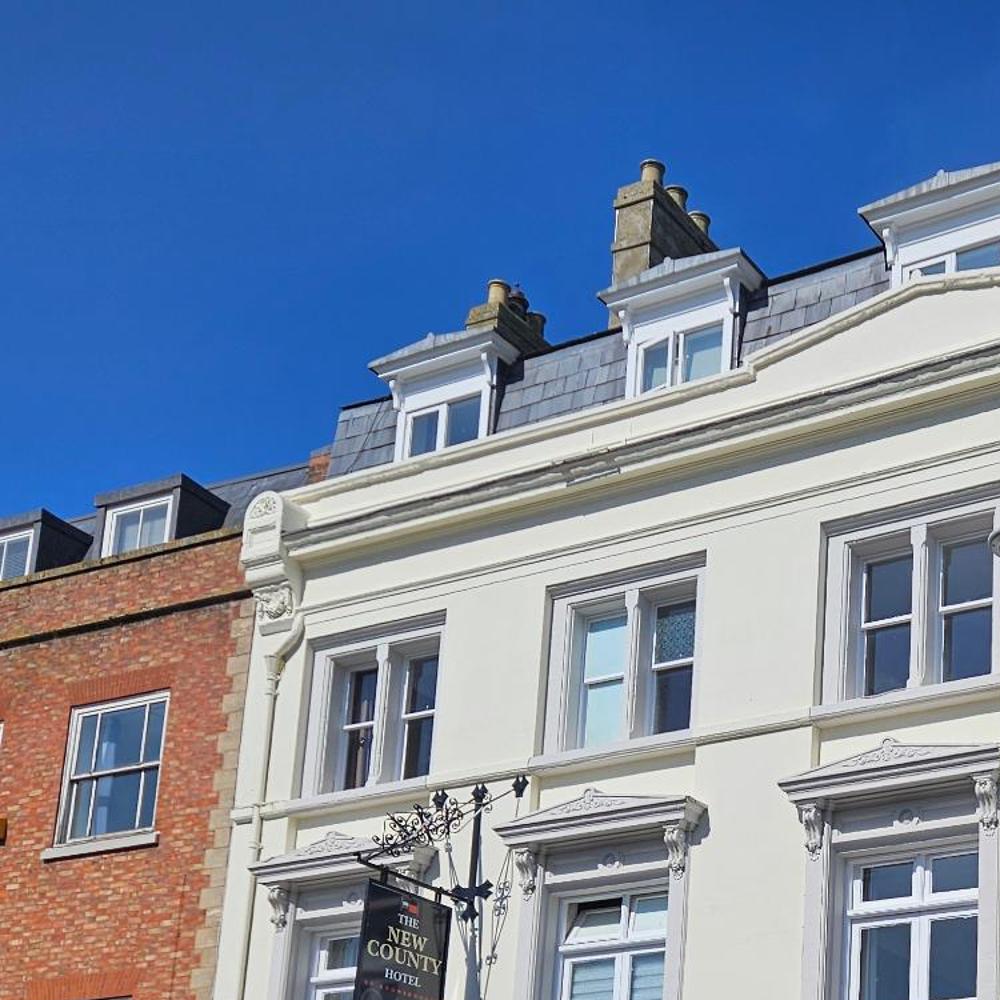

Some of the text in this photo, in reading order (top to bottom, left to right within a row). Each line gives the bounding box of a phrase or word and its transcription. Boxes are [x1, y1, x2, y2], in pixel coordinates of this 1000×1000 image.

[398, 913, 420, 930] THE
[386, 925, 428, 952] NEW
[367, 939, 443, 976] COUNTY
[384, 967, 422, 988] HOTEL
